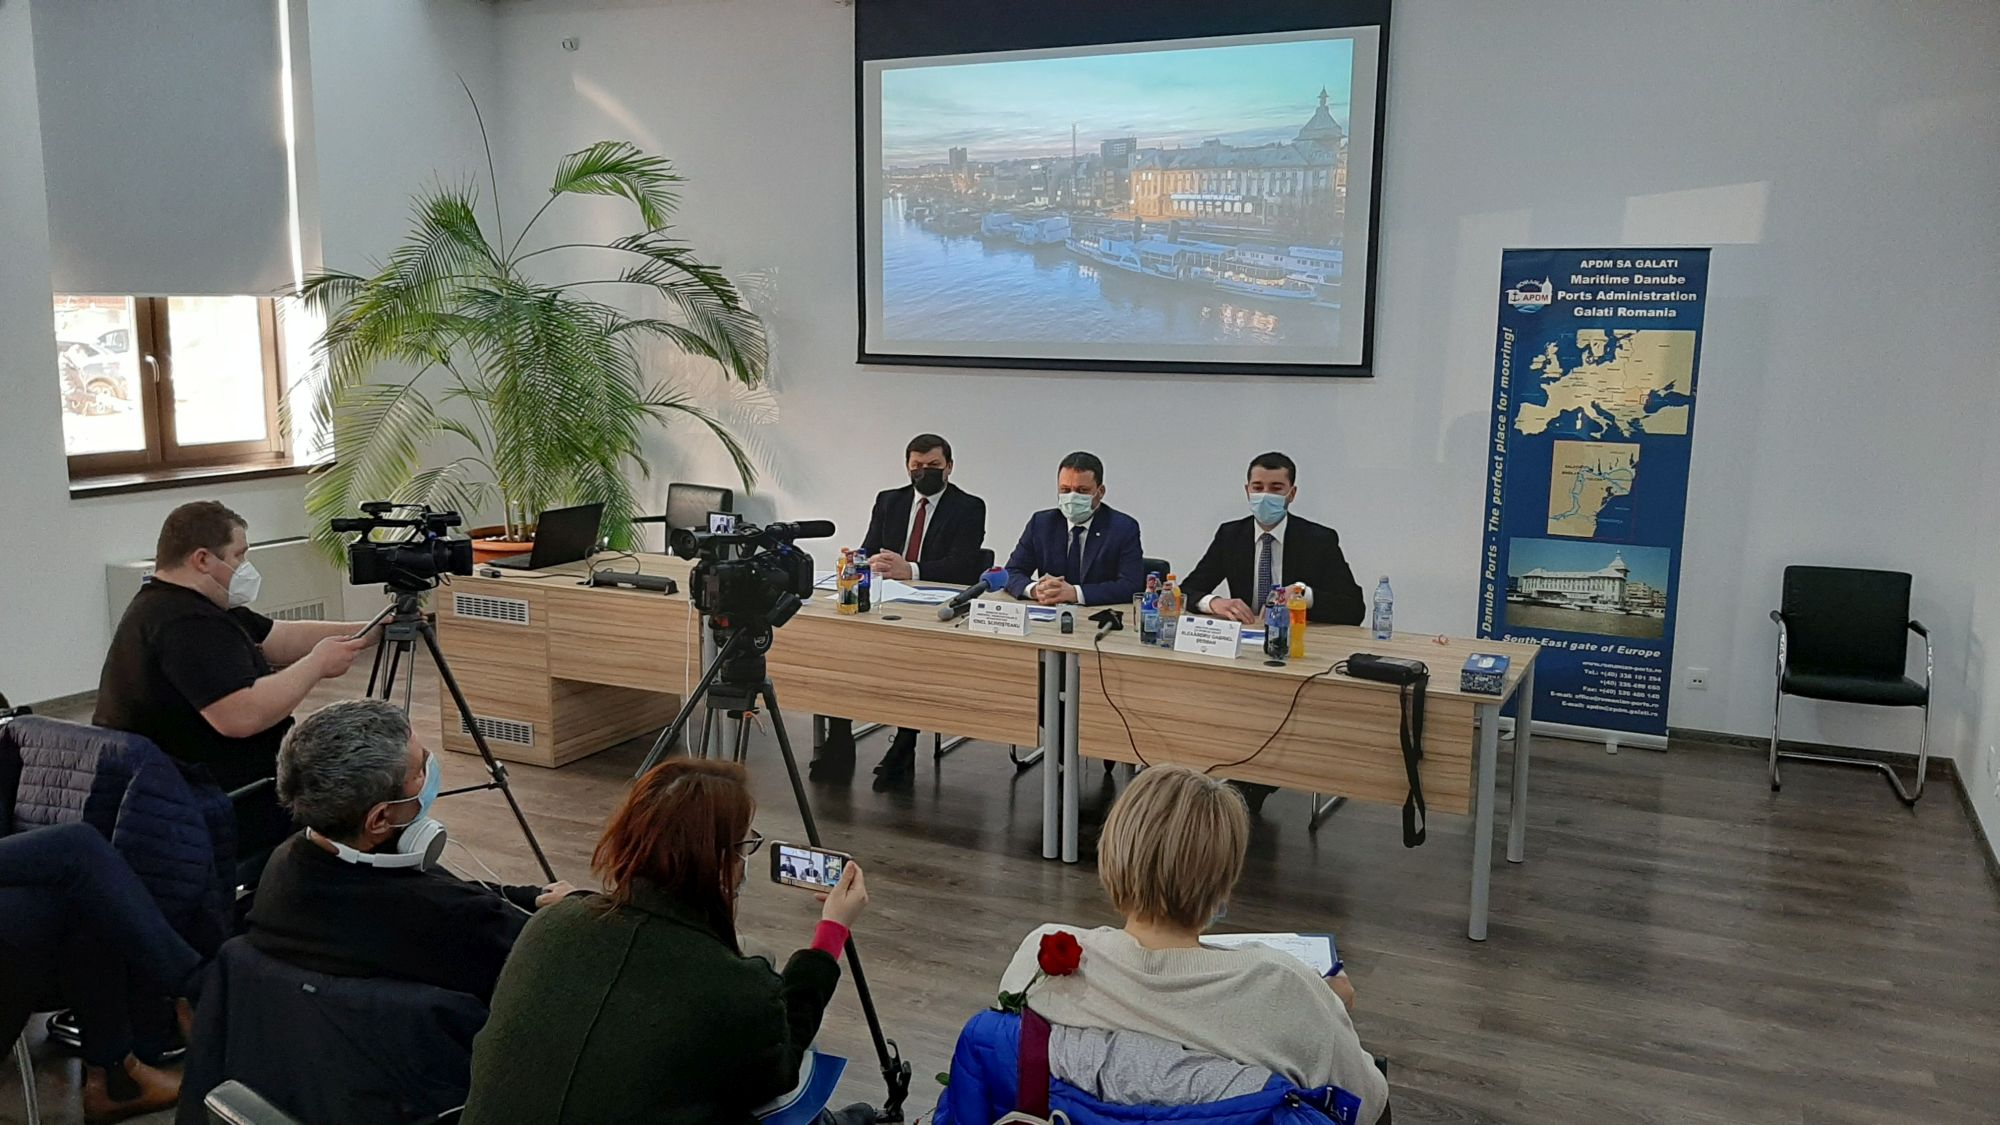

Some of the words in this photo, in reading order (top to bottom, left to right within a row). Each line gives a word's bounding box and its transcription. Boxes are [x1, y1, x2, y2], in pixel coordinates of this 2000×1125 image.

[1580, 260, 1613, 268] APDM
[1616, 260, 1632, 268] SA
[1635, 260, 1678, 268] GALATI
[1571, 274, 1630, 284] Maritime
[1634, 275, 1686, 284] Danube
[1558, 291, 1592, 300] Ports
[1596, 290, 1697, 302] Administration
[1574, 307, 1613, 317] Galati
[1617, 307, 1677, 318] Romania
[1500, 327, 1514, 388] mooring!
[1497, 391, 1508, 411] for
[1494, 415, 1506, 453] place
[1492, 456, 1504, 506] perfect
[1488, 508, 1500, 532] The
[1486, 544, 1498, 580] Ports
[1482, 585, 1494, 632] Danube
[1502, 634, 1568, 648] South-East
[1570, 642, 1598, 651] gate
[1600, 644, 1614, 653] of
[1616, 646, 1661, 658] Europe
